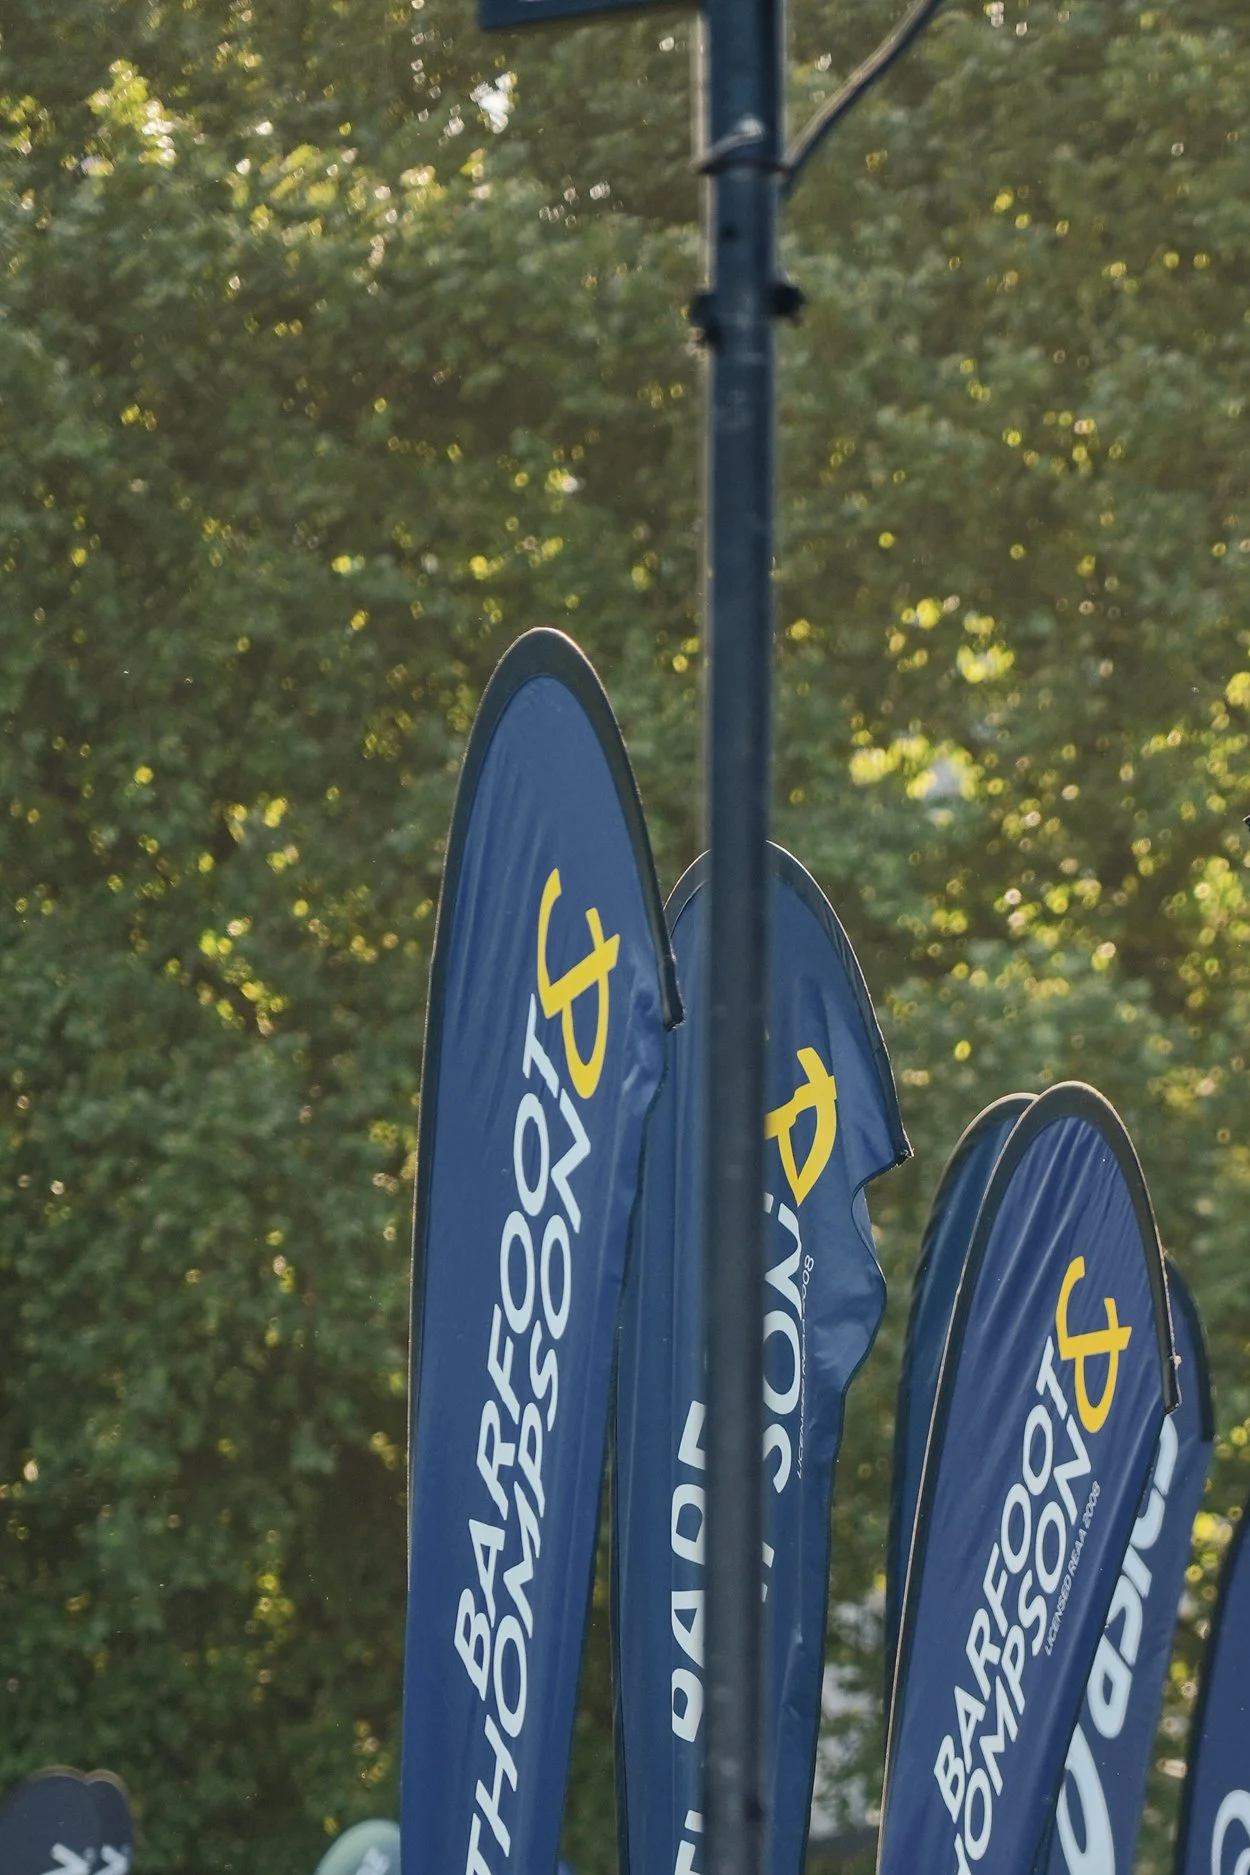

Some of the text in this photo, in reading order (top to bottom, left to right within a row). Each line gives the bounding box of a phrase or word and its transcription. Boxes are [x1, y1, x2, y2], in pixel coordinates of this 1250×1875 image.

[453, 868, 620, 1702] BARFOOT &
[934, 1256, 1133, 1824] BARFOOT &
[1045, 1480, 1101, 1656] LICENSED REAA 2008
